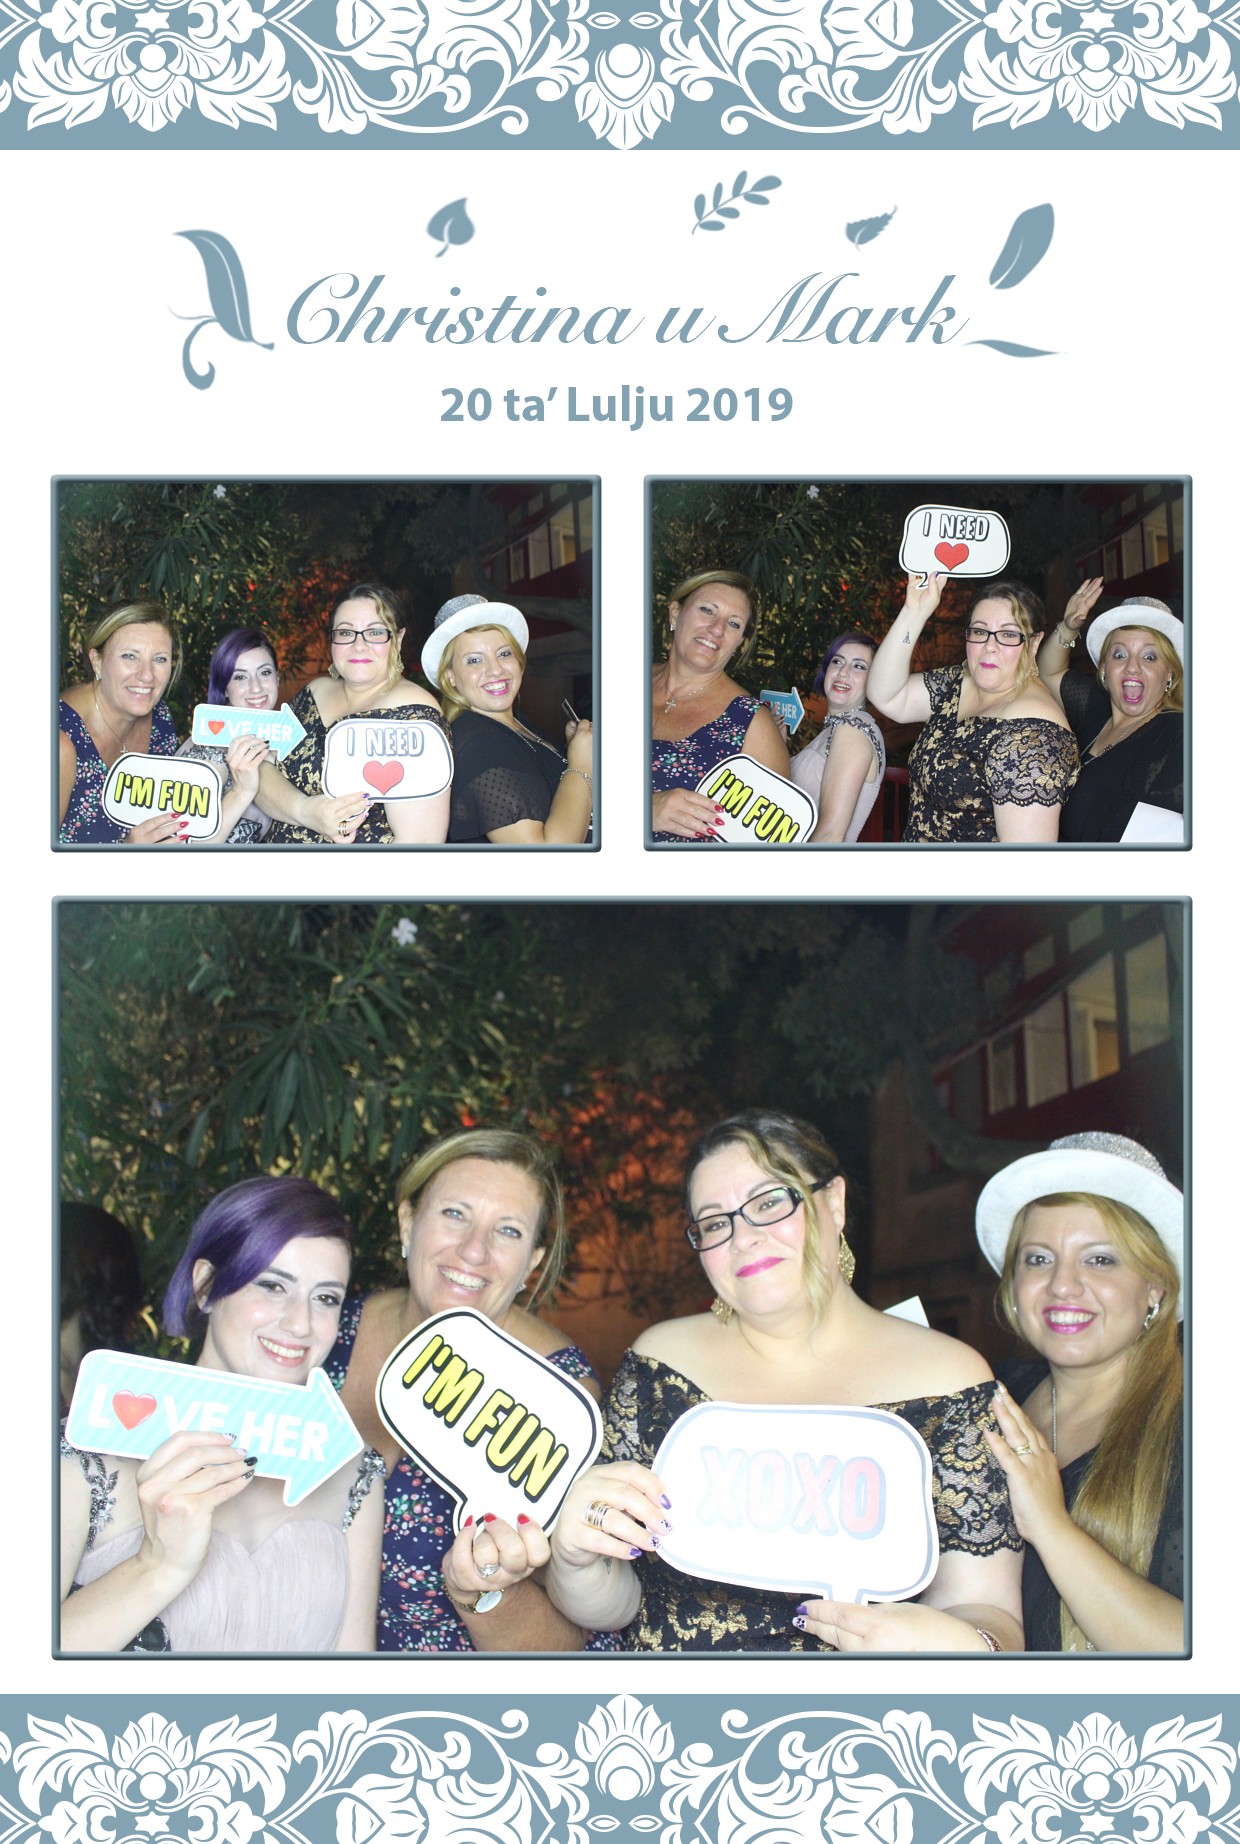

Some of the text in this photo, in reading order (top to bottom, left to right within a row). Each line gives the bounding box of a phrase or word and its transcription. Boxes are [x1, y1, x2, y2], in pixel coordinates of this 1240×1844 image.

[923, 512, 990, 541] I NEED
[257, 723, 293, 742] HER
[782, 703, 797, 719] HER
[346, 726, 425, 757] I NEED
[114, 771, 211, 818] I'M FUN
[707, 768, 754, 818] I'M
[239, 1410, 329, 1462] HER
[402, 1334, 569, 1503] I'M FUN
[696, 1445, 887, 1540] XOXO
